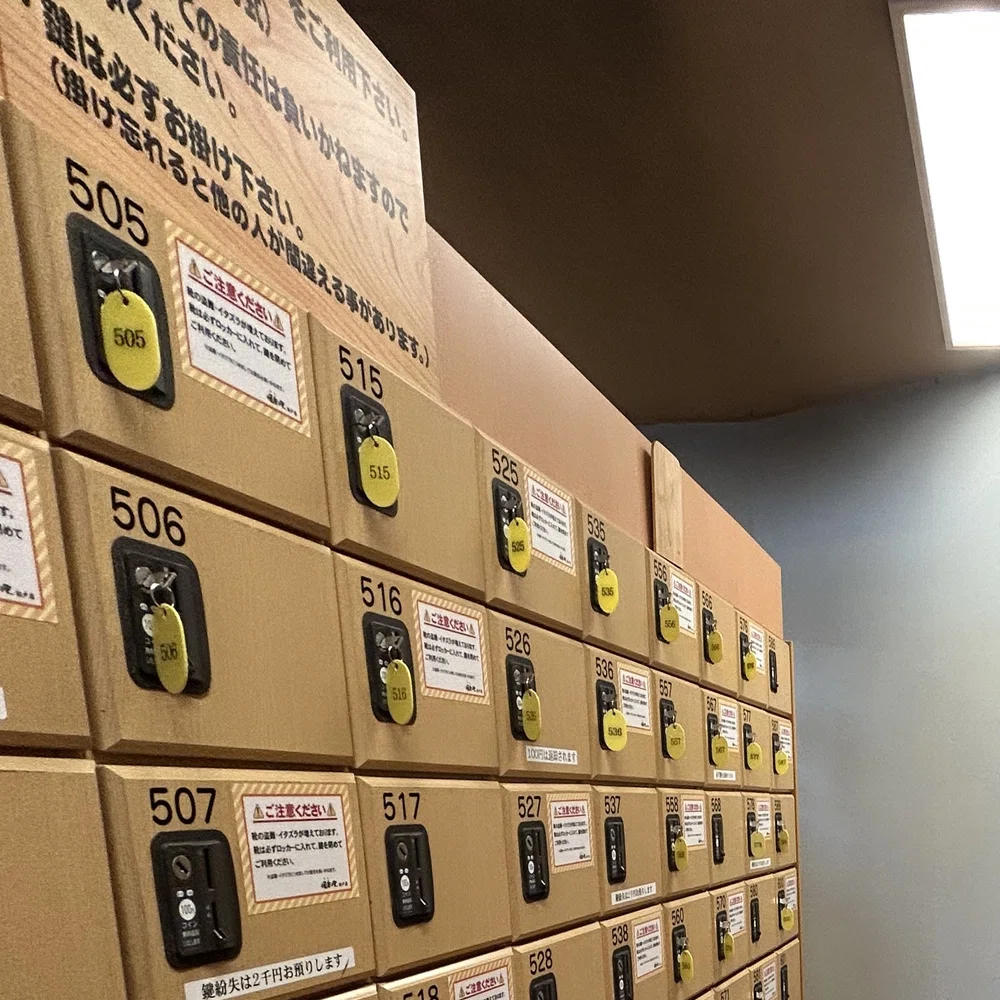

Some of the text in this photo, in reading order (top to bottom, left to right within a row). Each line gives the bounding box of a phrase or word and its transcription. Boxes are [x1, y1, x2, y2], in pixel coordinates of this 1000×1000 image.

[107, 0, 237, 118] ください。
[66, 157, 149, 246] 505
[203, 268, 273, 321] ご注意ください
[113, 327, 146, 349] 505
[338, 345, 383, 399] 515
[369, 465, 390, 480] 515
[492, 448, 519, 486] 525
[110, 486, 186, 547] 506
[587, 514, 606, 541] 535
[511, 541, 525, 552] 525
[653, 559, 667, 582] 556
[360, 576, 402, 615] 516
[601, 587, 614, 596] 535
[665, 620, 676, 628] 556
[505, 627, 531, 655] 526
[595, 657, 613, 679] 536
[659, 679, 672, 697] 557
[706, 696, 717, 711] 567
[608, 726, 623, 736] 536
[670, 737, 681, 746] 557
[150, 787, 216, 825] 507
[265, 804, 327, 819] ご注意ください
[383, 793, 420, 821] 517
[518, 796, 541, 818] 527
[604, 796, 621, 814] 537
[666, 797, 679, 812] 558
[671, 908, 684, 926] 560
[612, 924, 629, 946] 538
[530, 949, 552, 974] 528
